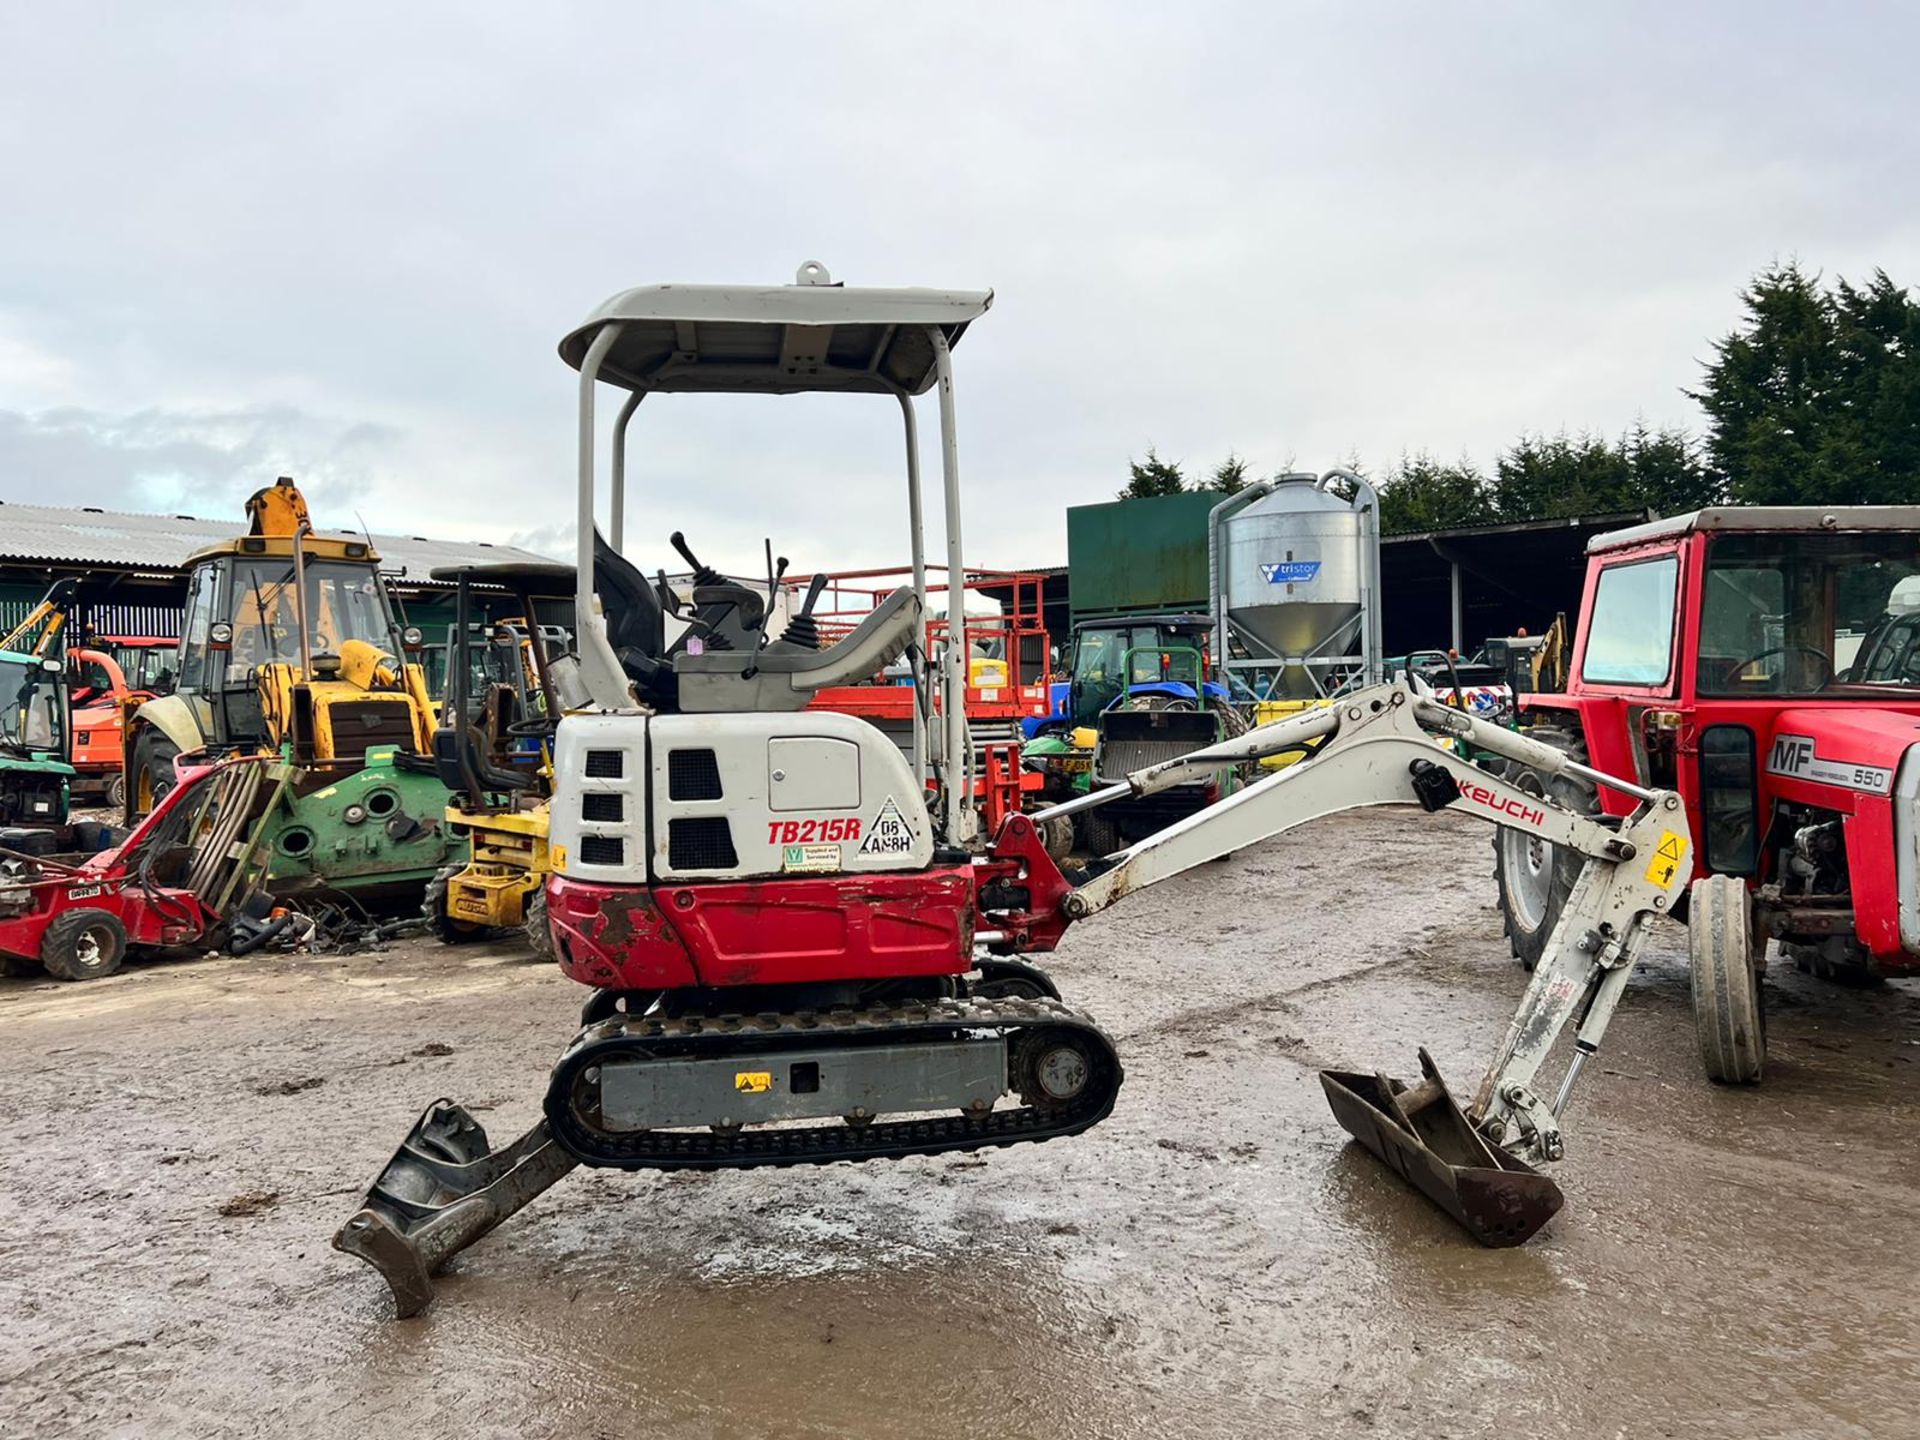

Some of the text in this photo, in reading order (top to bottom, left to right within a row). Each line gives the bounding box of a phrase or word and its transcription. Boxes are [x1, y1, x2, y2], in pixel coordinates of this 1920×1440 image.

[1280, 564, 1317, 573] tristor
[1773, 740, 1812, 772] MF
[1853, 769, 1884, 788] 550
[768, 818, 862, 844] TB215R
[881, 820, 899, 836] D8
